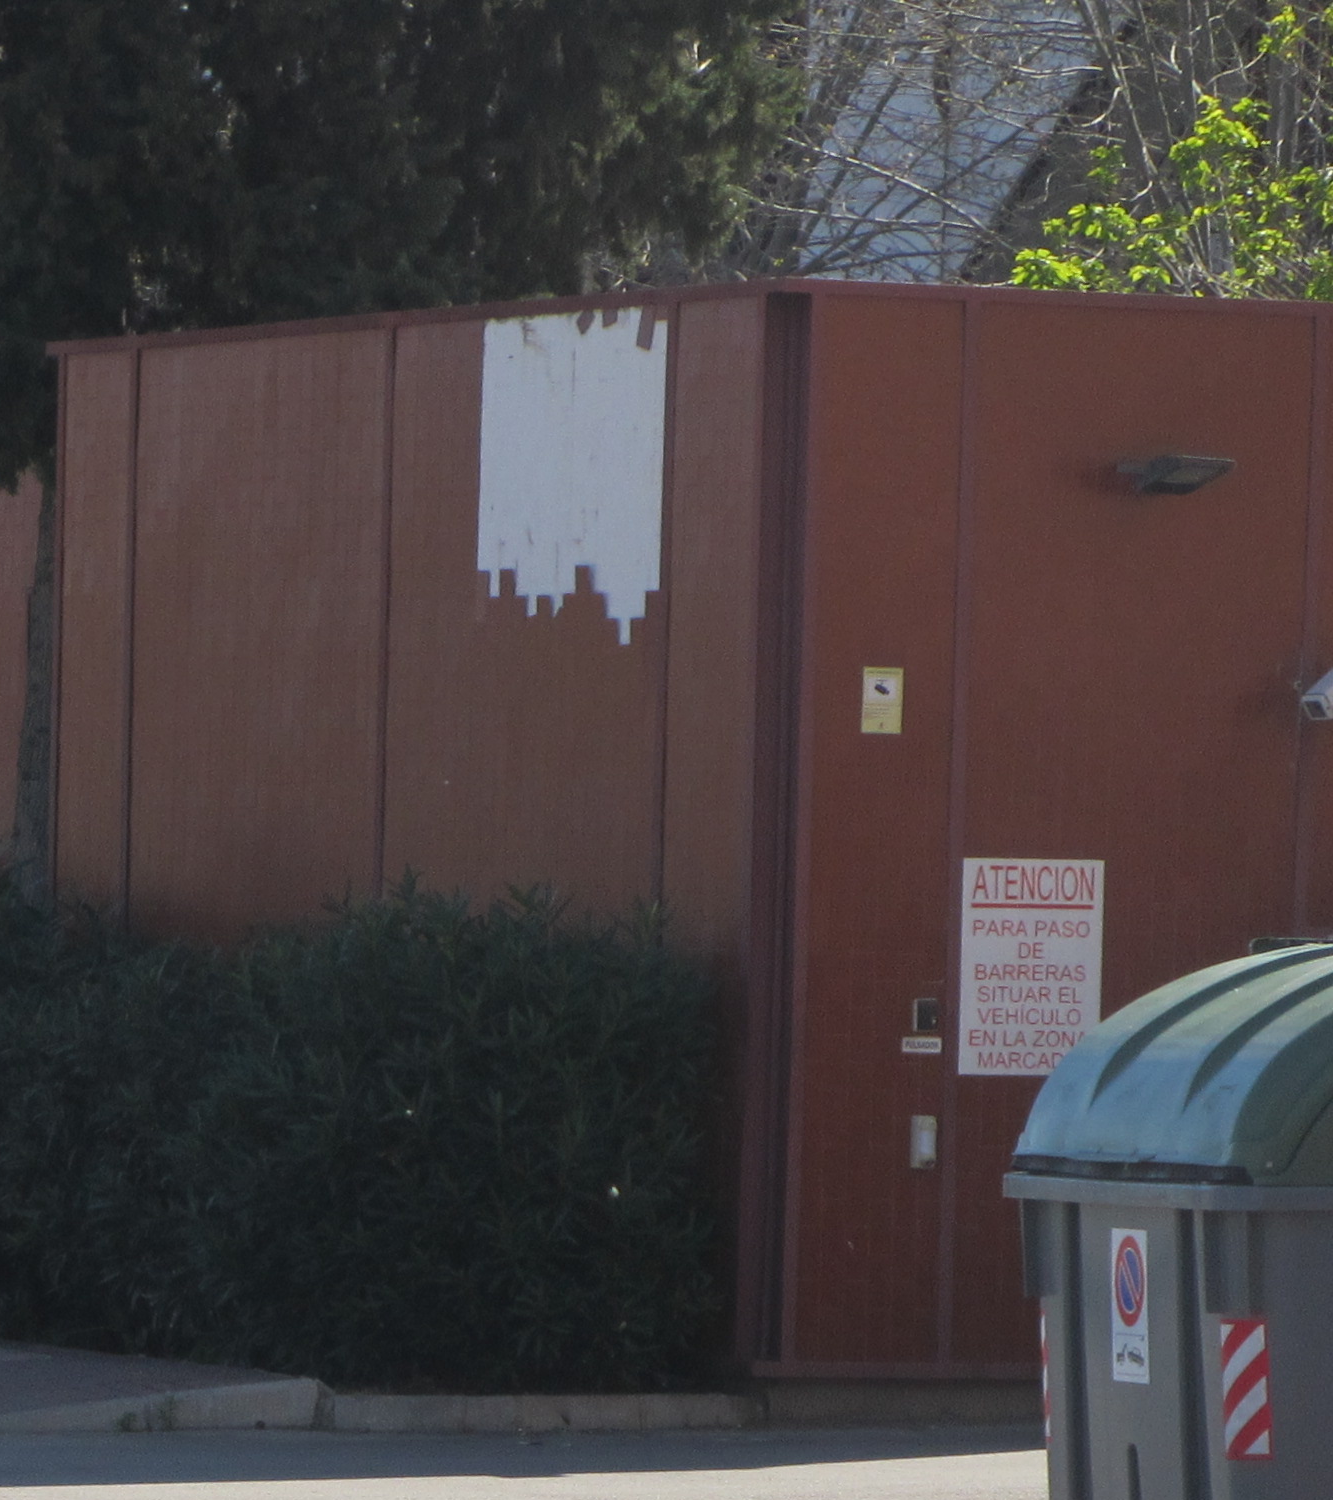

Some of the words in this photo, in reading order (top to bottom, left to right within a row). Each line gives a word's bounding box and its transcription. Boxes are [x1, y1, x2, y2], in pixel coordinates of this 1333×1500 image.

[972, 865, 1095, 901] ATENCION
[972, 920, 1027, 937] PARA
[1034, 921, 1091, 938] PASO
[1018, 942, 1044, 959] DE
[974, 964, 1086, 982] BARRERAS
[977, 986, 1051, 1004] SITUAR
[1058, 987, 1082, 1004] EL
[977, 1004, 1082, 1026] VEHÍCULO
[969, 1030, 996, 1046] EN
[1003, 1031, 1027, 1047] LA
[978, 1052, 1065, 1070] MARCAD
